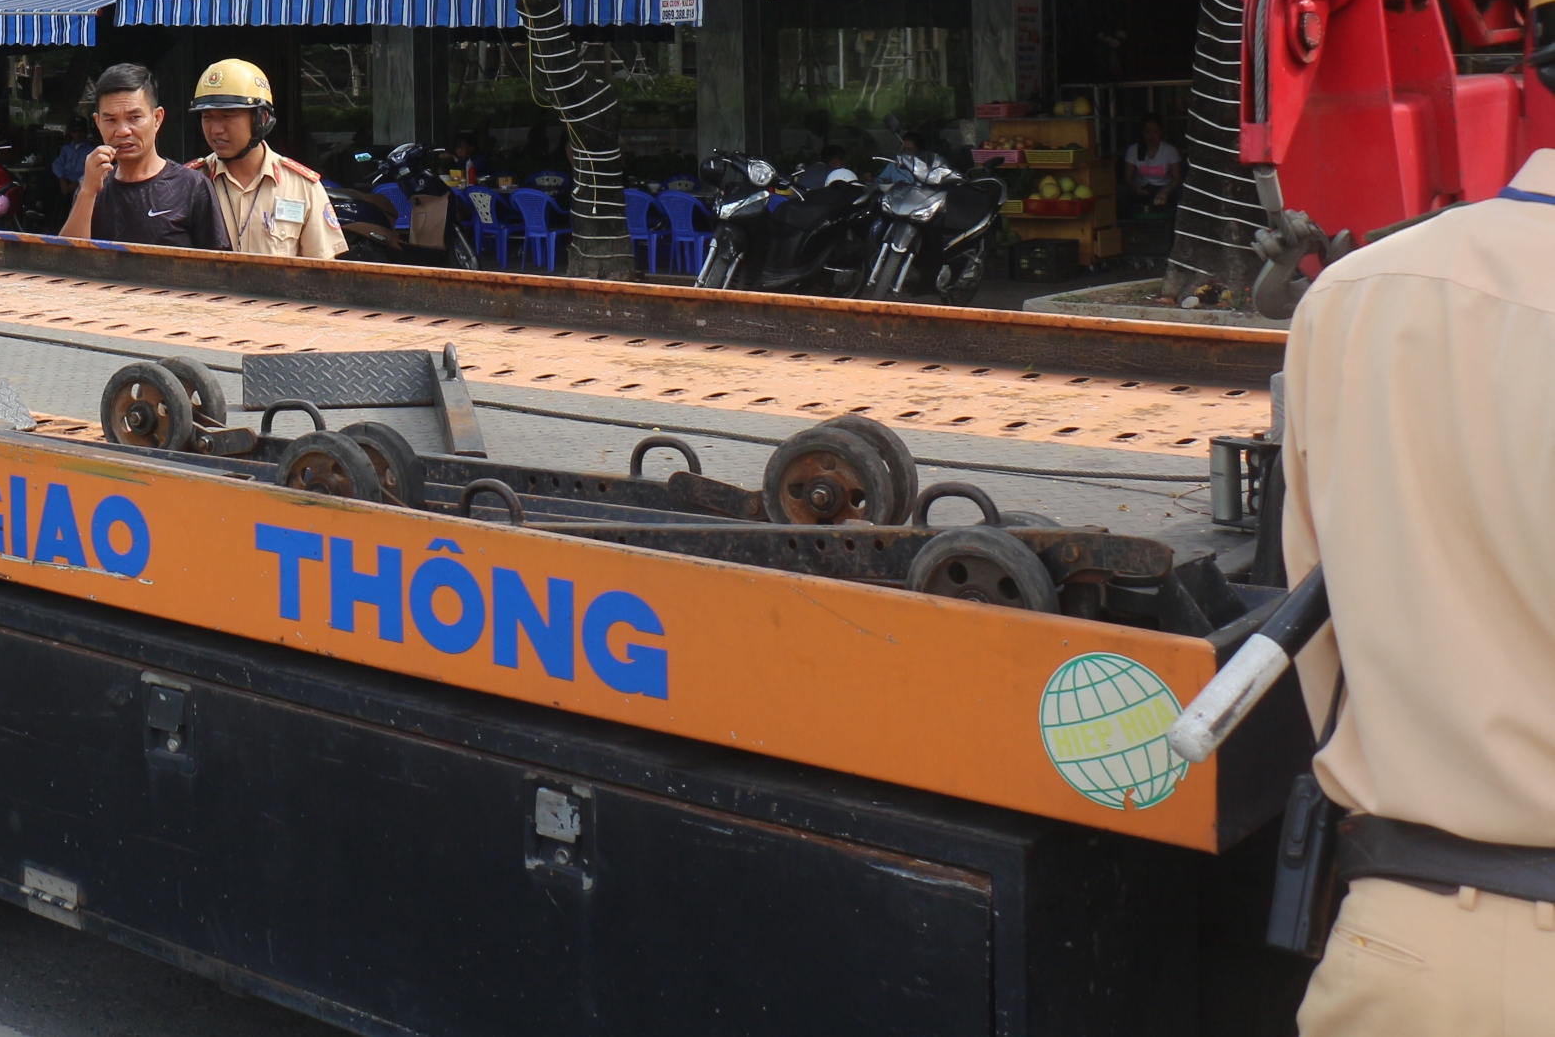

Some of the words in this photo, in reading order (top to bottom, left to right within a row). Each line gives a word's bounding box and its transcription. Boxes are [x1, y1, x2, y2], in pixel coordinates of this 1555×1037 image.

[254, 522, 669, 700] THÔNG
[1051, 720, 1112, 758] HIEP
[1116, 698, 1176, 744] HOA
